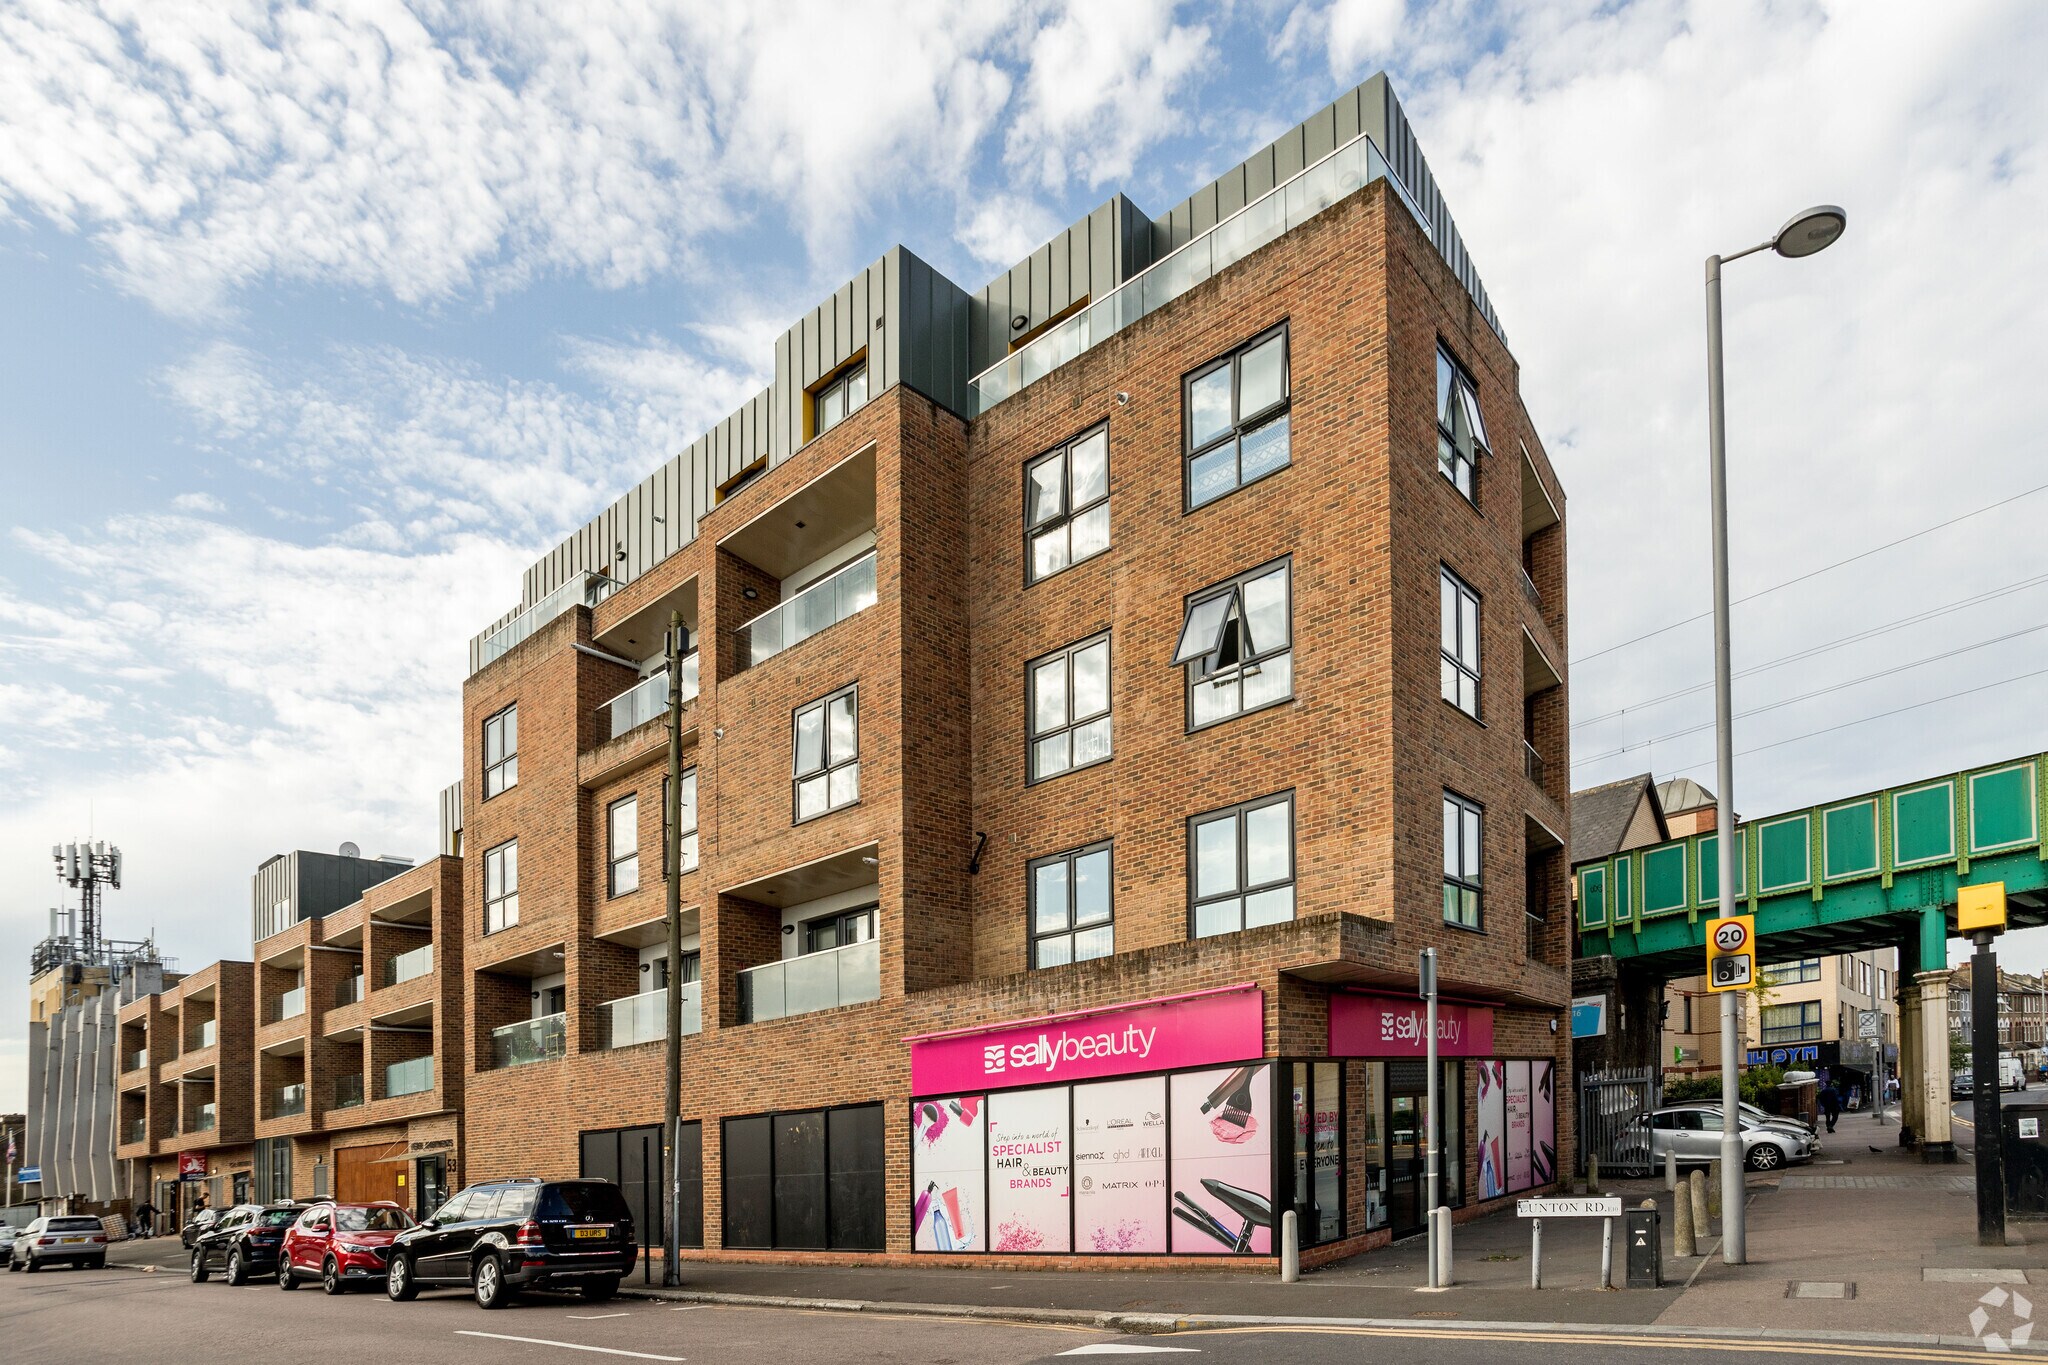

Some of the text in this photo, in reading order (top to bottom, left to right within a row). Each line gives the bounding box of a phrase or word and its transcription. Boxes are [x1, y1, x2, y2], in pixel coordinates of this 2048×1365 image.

[1718, 929, 1742, 944] 20
[1396, 1010, 1461, 1047] sallybauty
[1771, 1045, 1819, 1065] GYM
[1506, 1094, 1528, 1104] SPECIALIST
[1511, 1121, 1525, 1129] BRANDS
[996, 1133, 1010, 1143] Step
[1012, 1132, 1024, 1141] into
[1032, 1130, 1050, 1139] world
[992, 1141, 1062, 1157] SPECIALIST
[1113, 1148, 1130, 1163] ghd
[447, 1159, 457, 1173] 53
[997, 1157, 1069, 1177] HAIR & BEAUTY
[1010, 1177, 1052, 1189] BRANDS
[1102, 1181, 1139, 1190] MATRIX
[1585, 1202, 1607, 1213] RD.
[589, 1229, 602, 1237] URS
